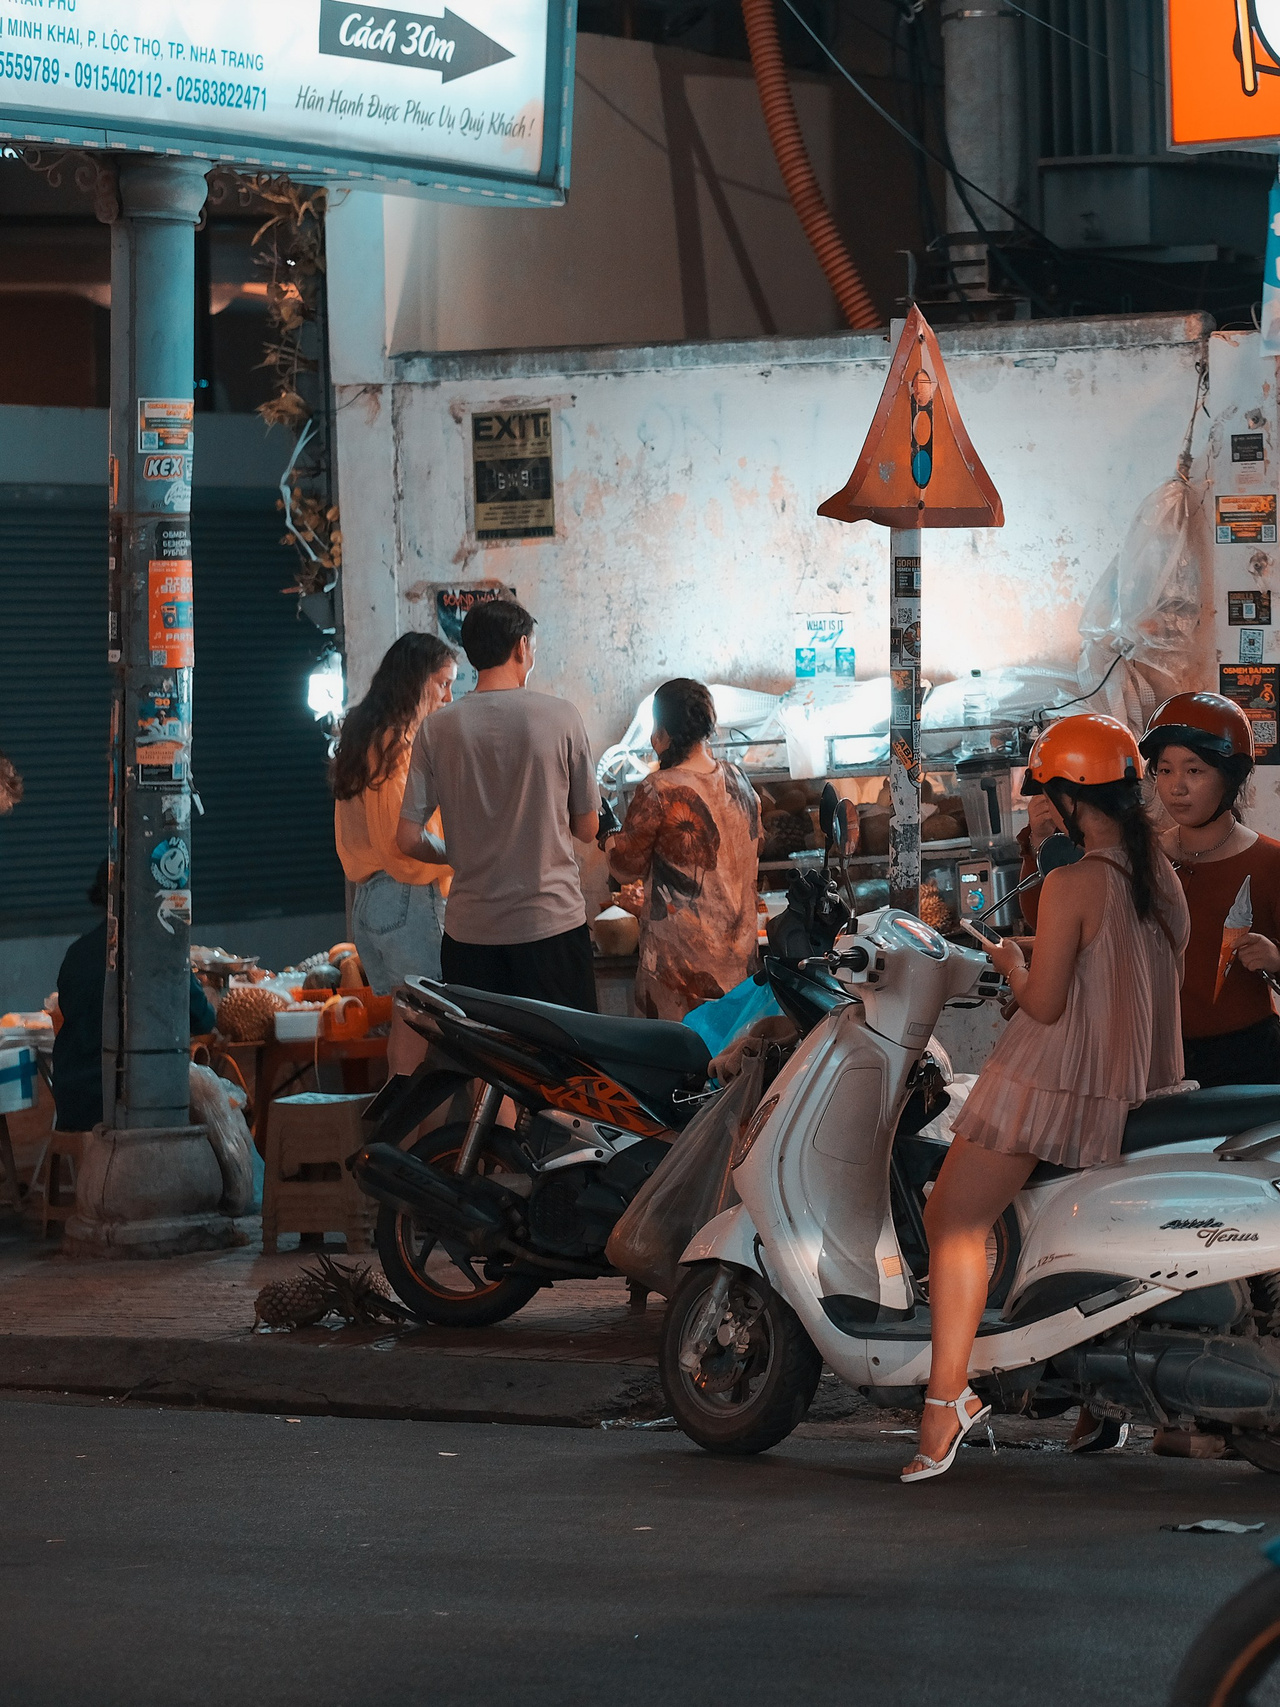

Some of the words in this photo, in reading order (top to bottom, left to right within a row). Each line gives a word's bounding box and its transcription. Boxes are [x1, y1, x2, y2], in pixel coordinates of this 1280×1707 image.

[7, 18, 42, 40] MINH
[47, 24, 83, 49] KHAI,
[88, 30, 97, 49] P.
[102, 29, 129, 55] LỘC
[133, 36, 164, 61] THỌ,
[168, 42, 186, 61] TP.
[190, 45, 216, 65] NHA
[221, 49, 264, 72] TRANG
[339, 13, 397, 54] Cách
[400, 22, 456, 63] 30m
[74, 61, 162, 98] 0915402112
[176, 75, 267, 112] 02583822471
[295, 85, 323, 111] Hân
[328, 90, 364, 120] Hạnh
[367, 94, 400, 125] Được
[403, 99, 436, 131] Phục
[459, 107, 485, 140] Quý
[474, 412, 548, 441] EXIT
[148, 457, 181, 477] KEX
[806, 620, 826, 631] WHAT
[828, 620, 836, 631] IS
[837, 620, 844, 631] IT
[1196, 1228, 1260, 1248] Venus
[1037, 1253, 1056, 1268] 125
